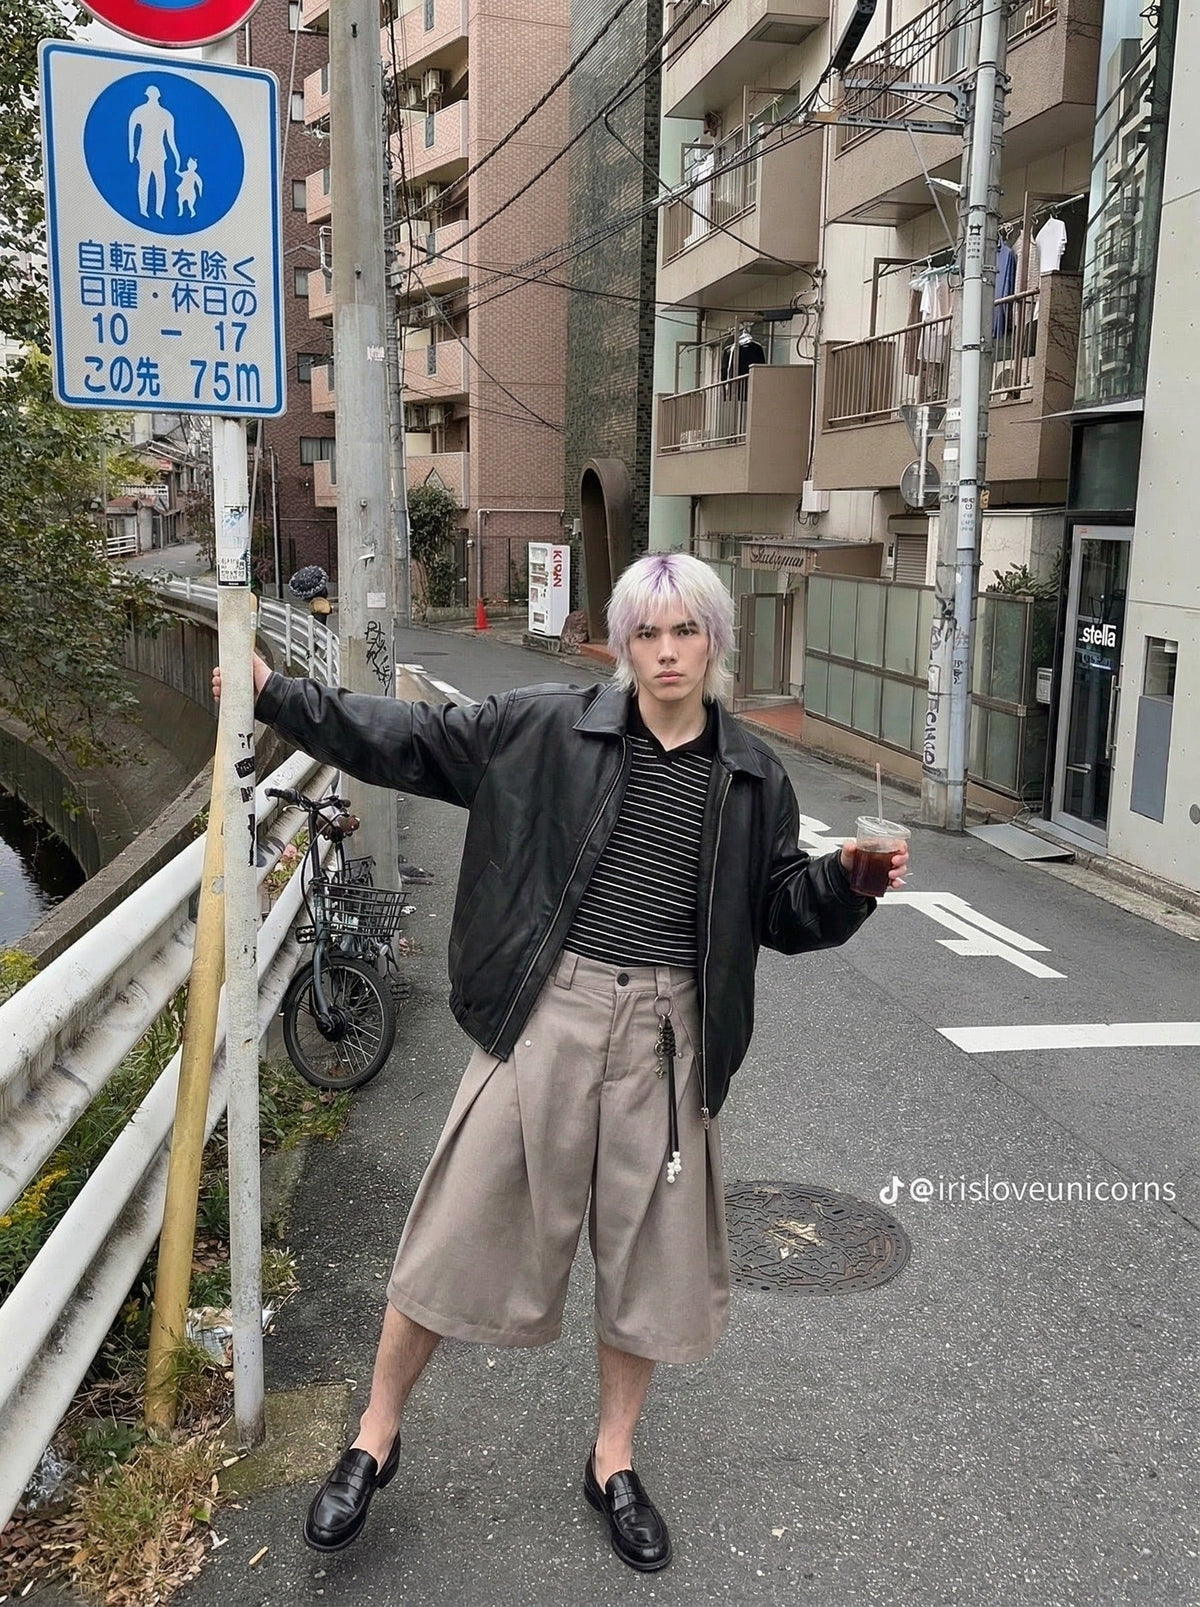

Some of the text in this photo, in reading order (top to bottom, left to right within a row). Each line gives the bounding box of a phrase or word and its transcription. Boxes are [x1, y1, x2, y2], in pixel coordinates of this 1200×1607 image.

[79, 239, 255, 284] 自転車を除く
[81, 276, 257, 317] 日曜・休日の
[92, 312, 129, 345] 10
[215, 321, 248, 352] 17
[84, 356, 260, 403] この先 75m
[1079, 623, 1117, 648] stella
